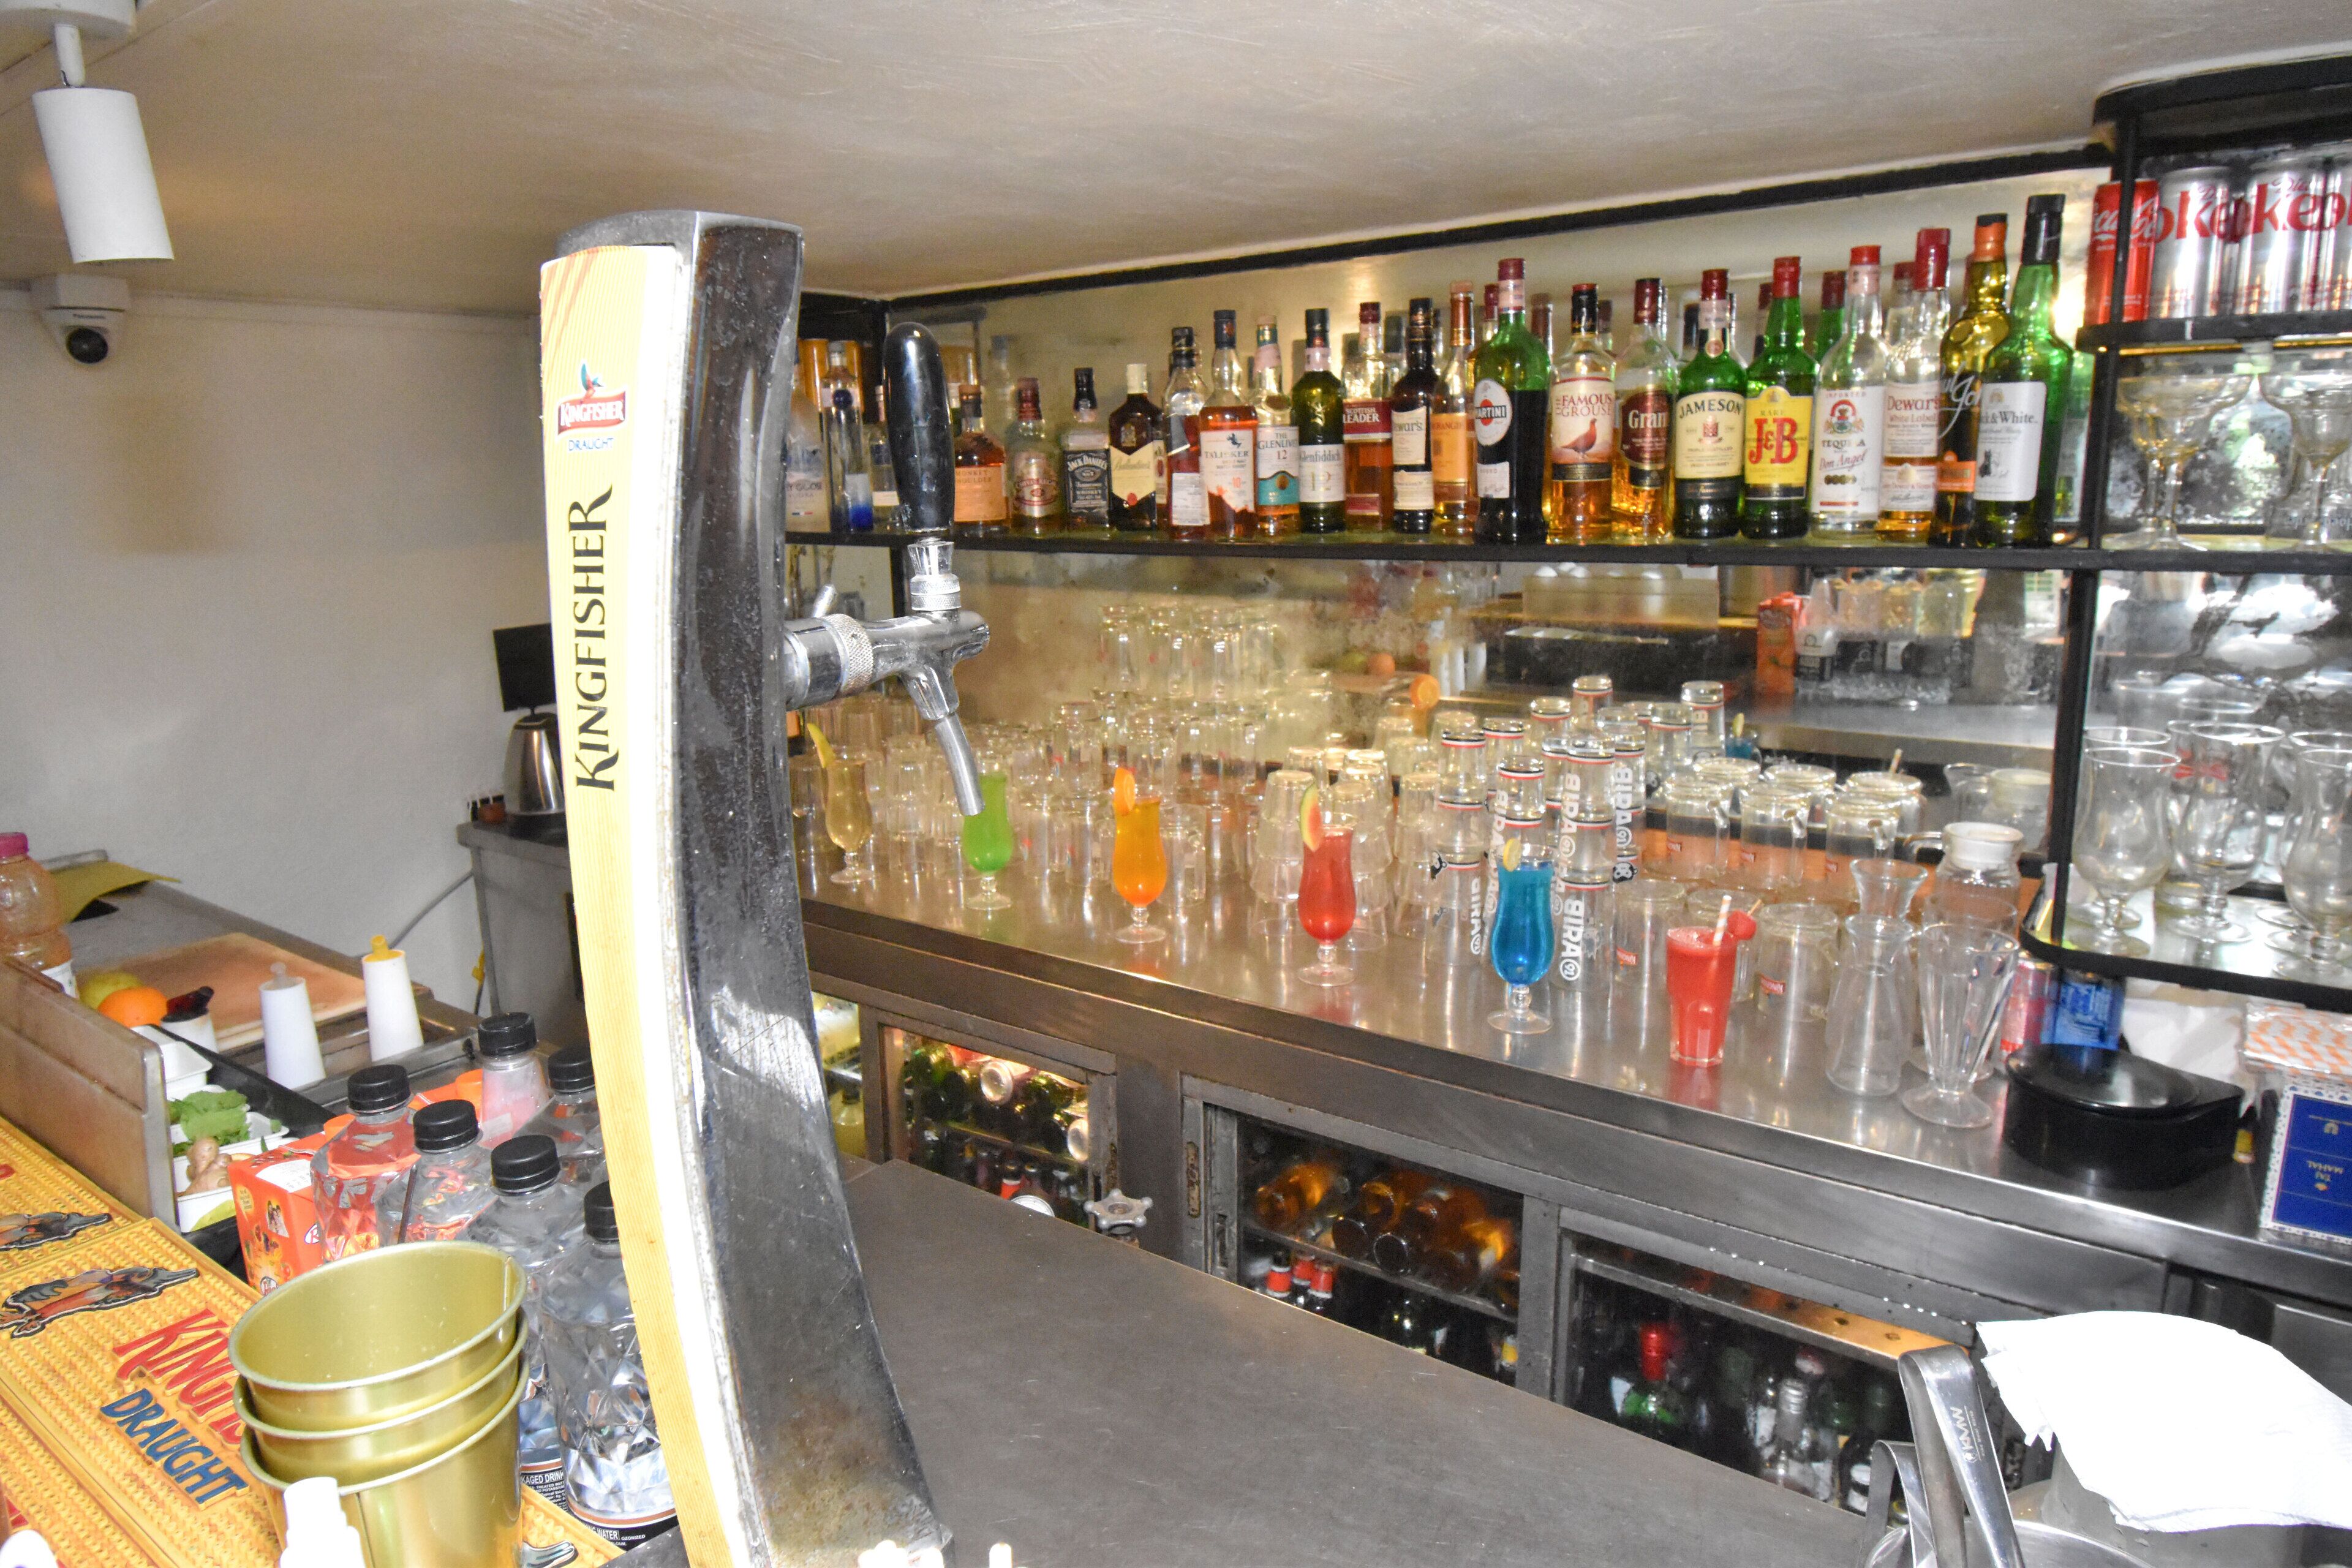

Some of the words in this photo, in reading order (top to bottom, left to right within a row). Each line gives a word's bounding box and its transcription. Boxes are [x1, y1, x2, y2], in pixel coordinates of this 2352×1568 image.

[1562, 393, 1612, 407] FAMOUS
[1679, 399, 1741, 419] JAMESON
[560, 400, 625, 428] KINGFISHER
[1343, 413, 1379, 423] LEADER
[1562, 405, 1611, 418] GROUSE
[569, 437, 614, 451] DRAUGHT
[1748, 417, 1798, 464] J&B
[1276, 450, 1287, 459] 12
[568, 483, 619, 793] KINGFISHER
[1560, 774, 1581, 834] BIRA
[1561, 899, 1585, 959] BIRA
[1559, 959, 1581, 981] 91
[100, 1387, 249, 1504] DRAUGHT
[597, 1529, 619, 1540] WATER
